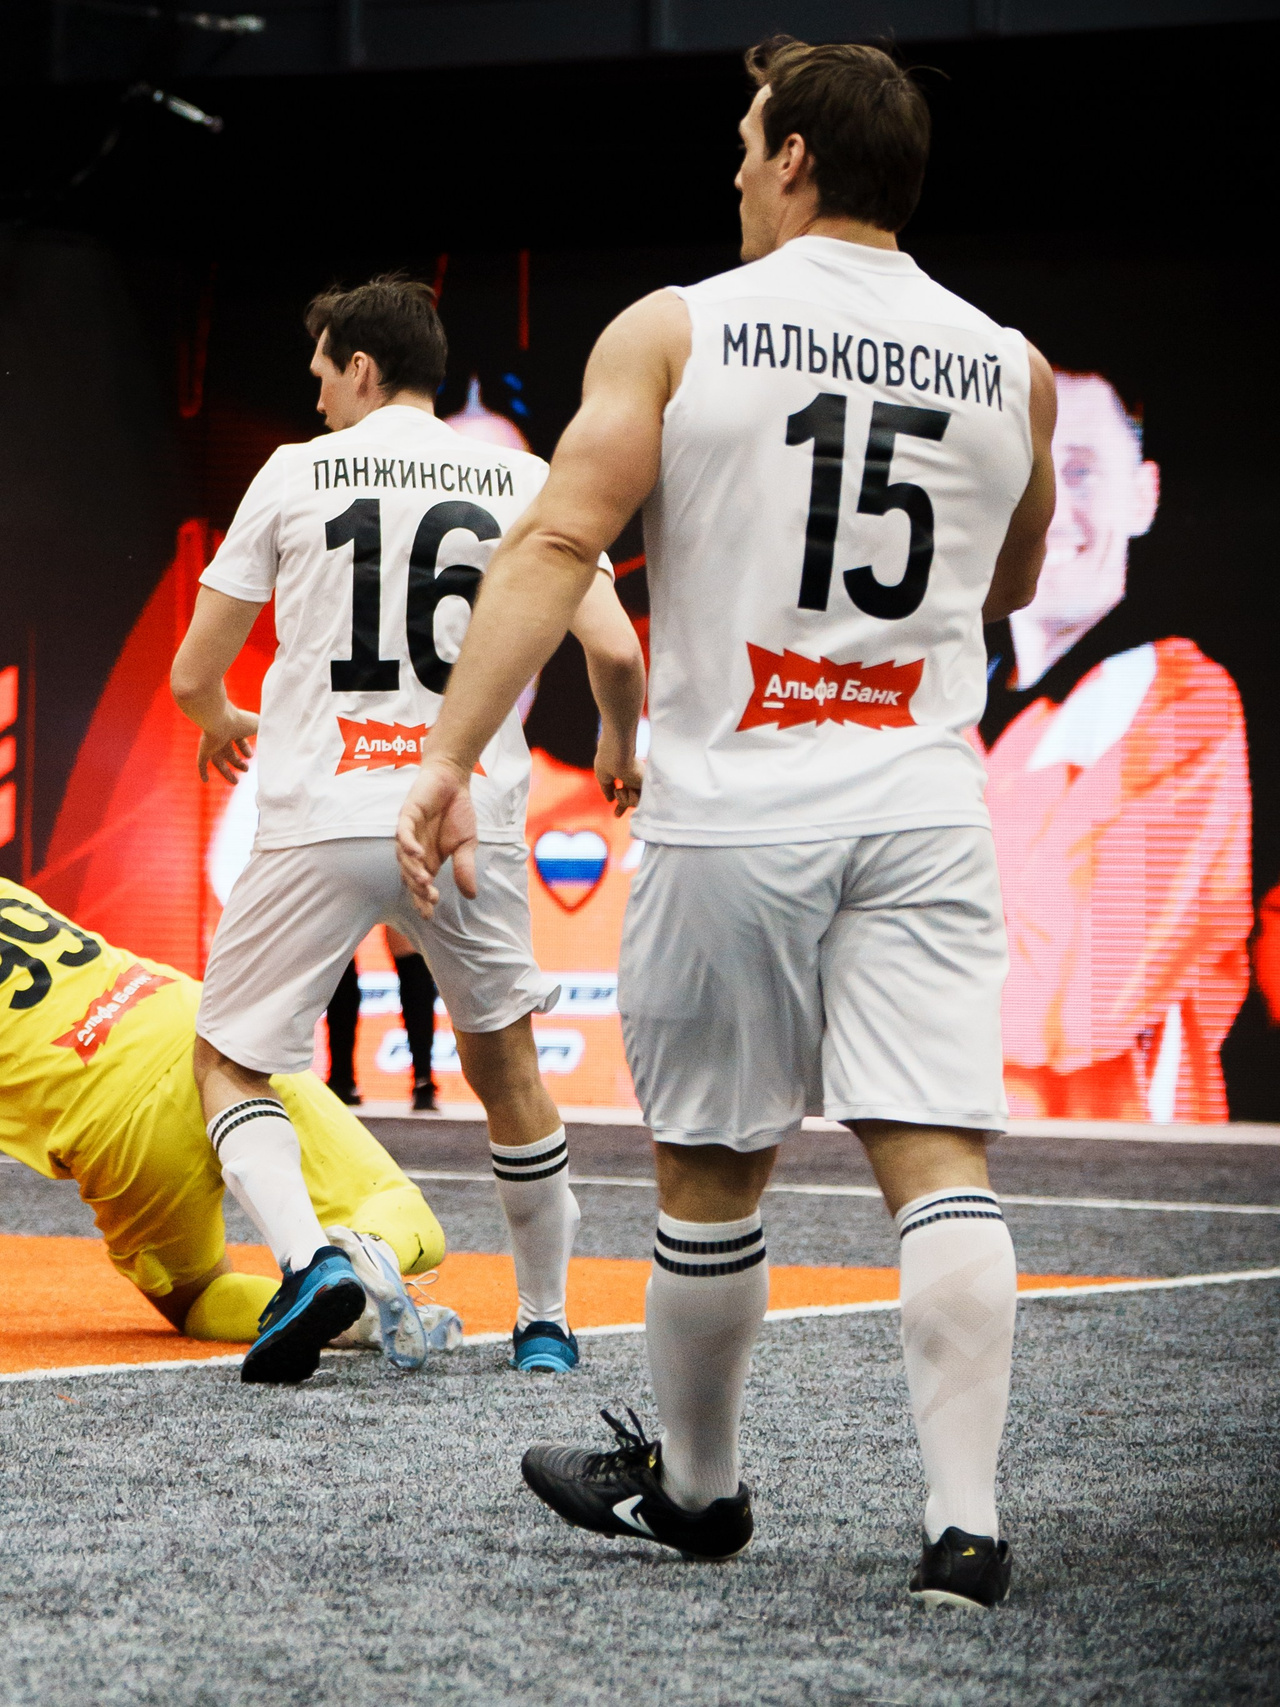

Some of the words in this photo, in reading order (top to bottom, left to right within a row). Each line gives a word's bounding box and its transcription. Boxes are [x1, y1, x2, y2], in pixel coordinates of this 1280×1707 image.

[722, 322, 1004, 412] МАЛЬКОВСКИЙ
[312, 456, 515, 498] ПАНЖИНСКИЙ
[784, 391, 952, 621] 15
[324, 497, 503, 696] 16
[762, 673, 839, 708] Альфа
[840, 678, 903, 706] Банк
[353, 735, 418, 758] Альфа
[76, 1002, 120, 1046] Альфа
[111, 974, 153, 1005] Банк
